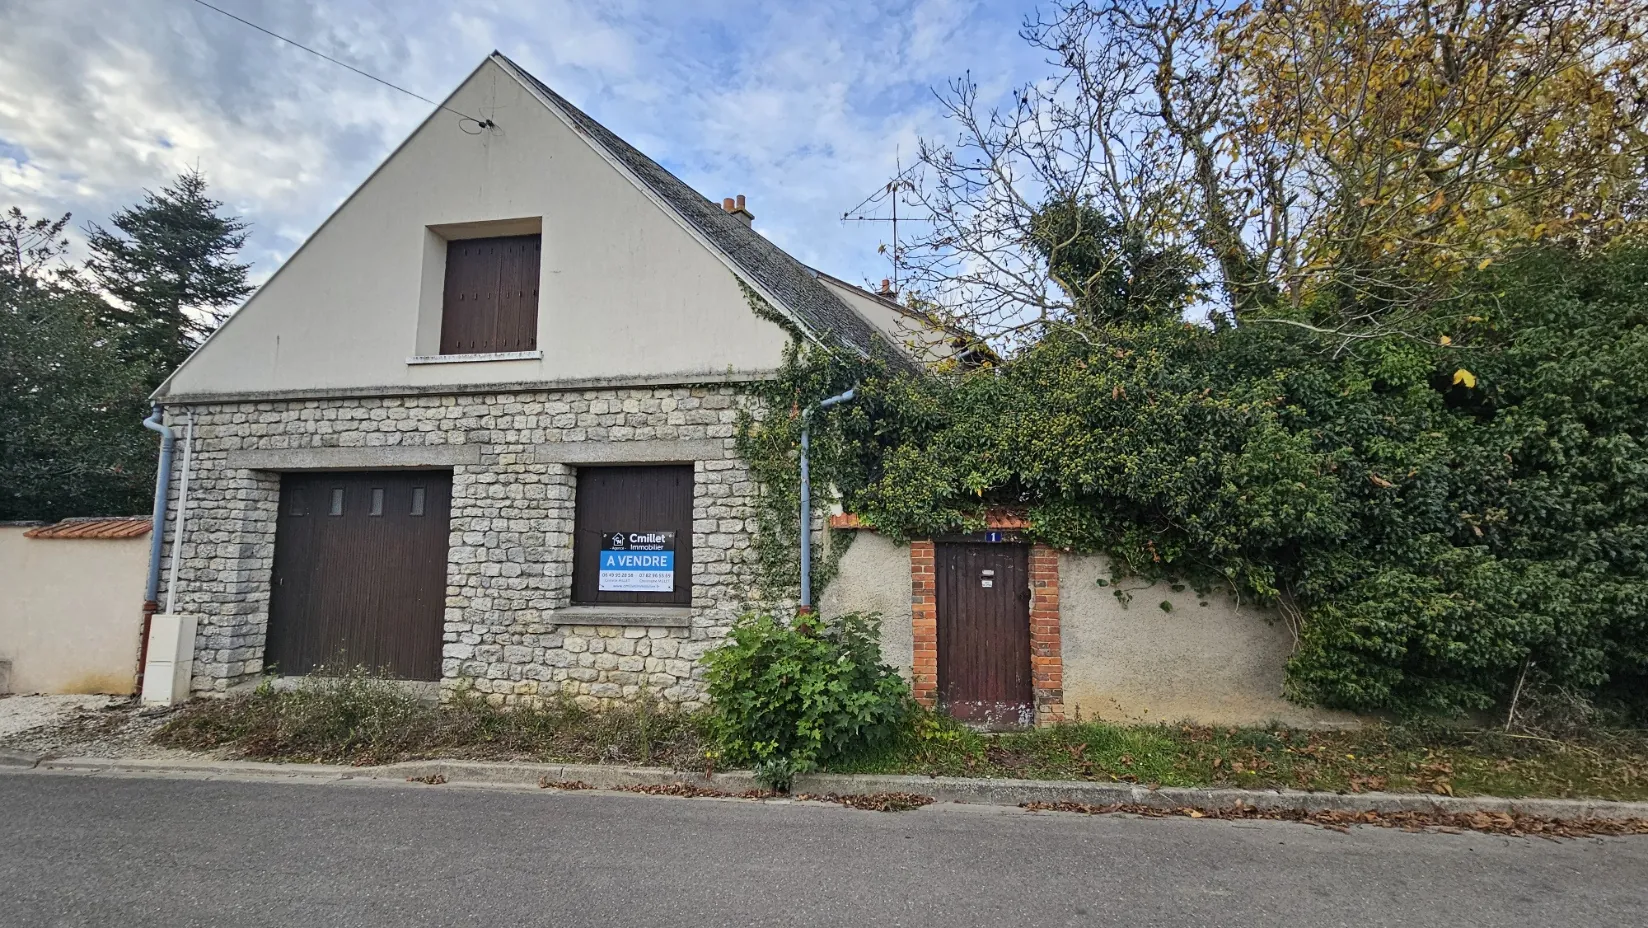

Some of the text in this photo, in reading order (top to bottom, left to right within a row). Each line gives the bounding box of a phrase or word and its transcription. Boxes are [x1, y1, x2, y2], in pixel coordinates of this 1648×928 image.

[629, 533, 666, 543] Cmillet
[991, 532, 996, 542] 1
[606, 555, 667, 566] A VENDRE
